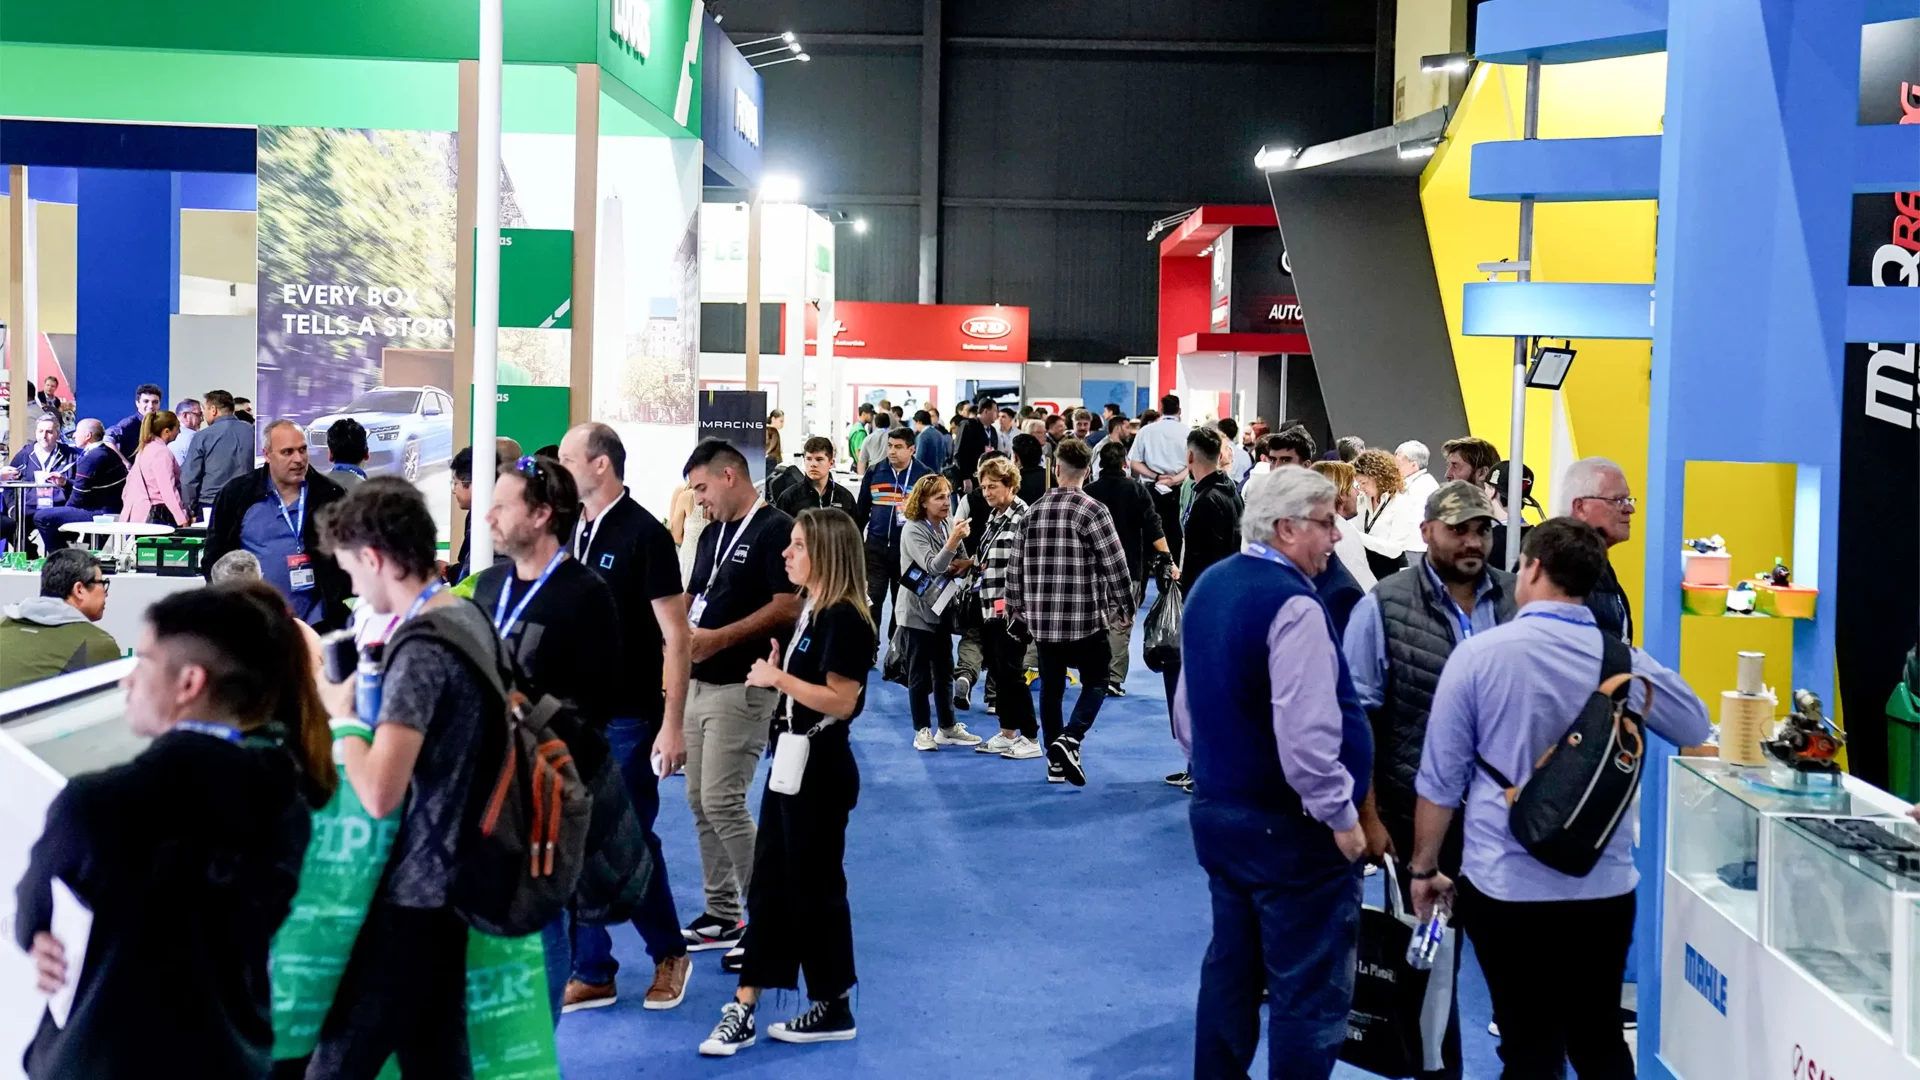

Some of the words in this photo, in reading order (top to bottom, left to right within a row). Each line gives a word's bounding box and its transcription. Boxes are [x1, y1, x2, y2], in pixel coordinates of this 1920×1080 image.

[283, 284, 360, 305] EVERY
[366, 286, 419, 309] BOX
[281, 313, 349, 336] TELLS
[356, 316, 377, 336] A
[969, 321, 1006, 333] RD
[1684, 941, 1728, 1018] MAHLE
